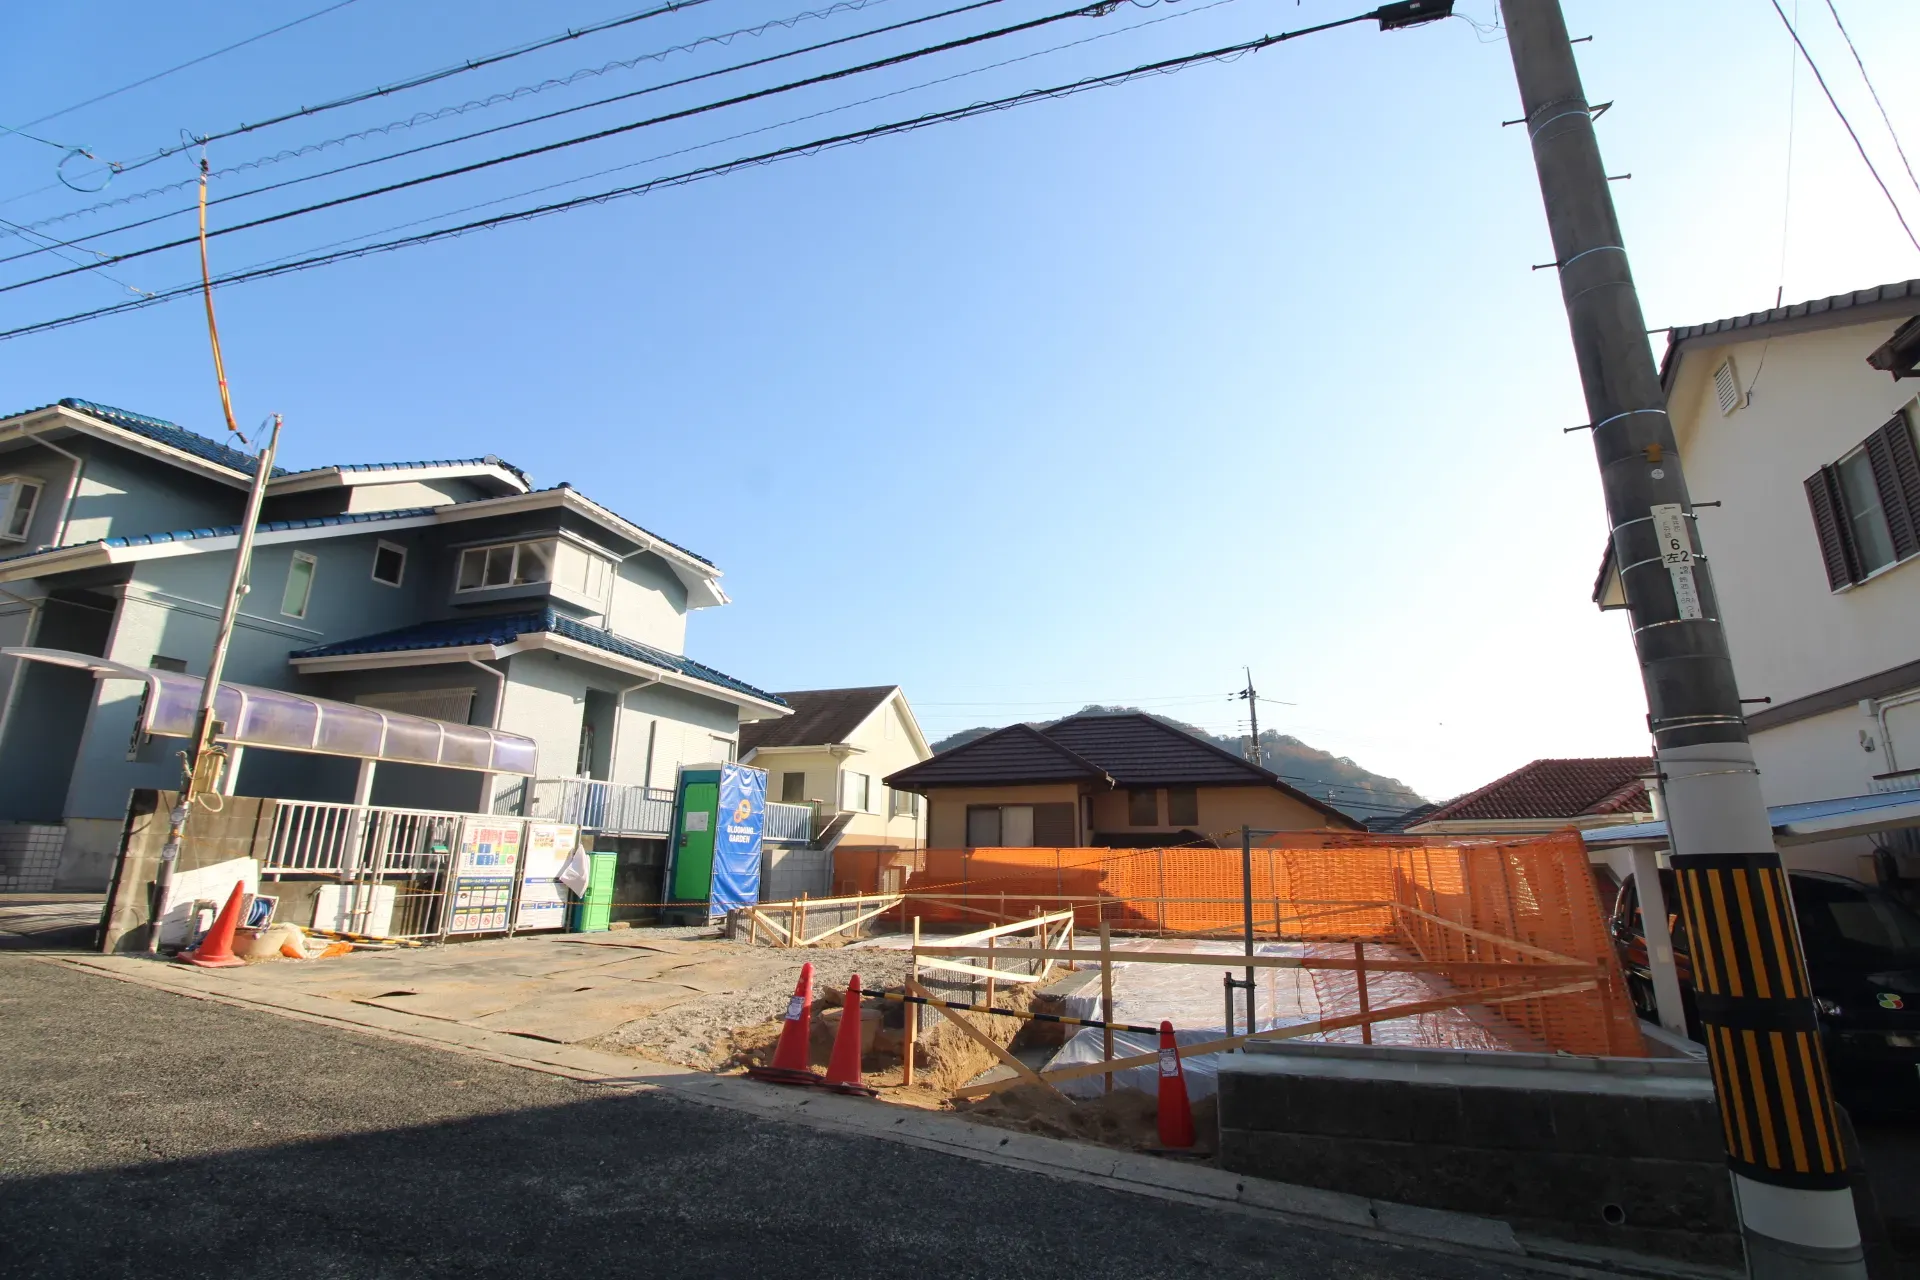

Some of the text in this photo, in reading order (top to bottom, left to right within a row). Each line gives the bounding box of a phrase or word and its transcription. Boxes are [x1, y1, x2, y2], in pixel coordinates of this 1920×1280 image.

[1670, 538, 1681, 550] 6
[1666, 550, 1690, 564] 左2
[727, 825, 754, 834] BLOOMING
[729, 834, 751, 843] GARDEN
